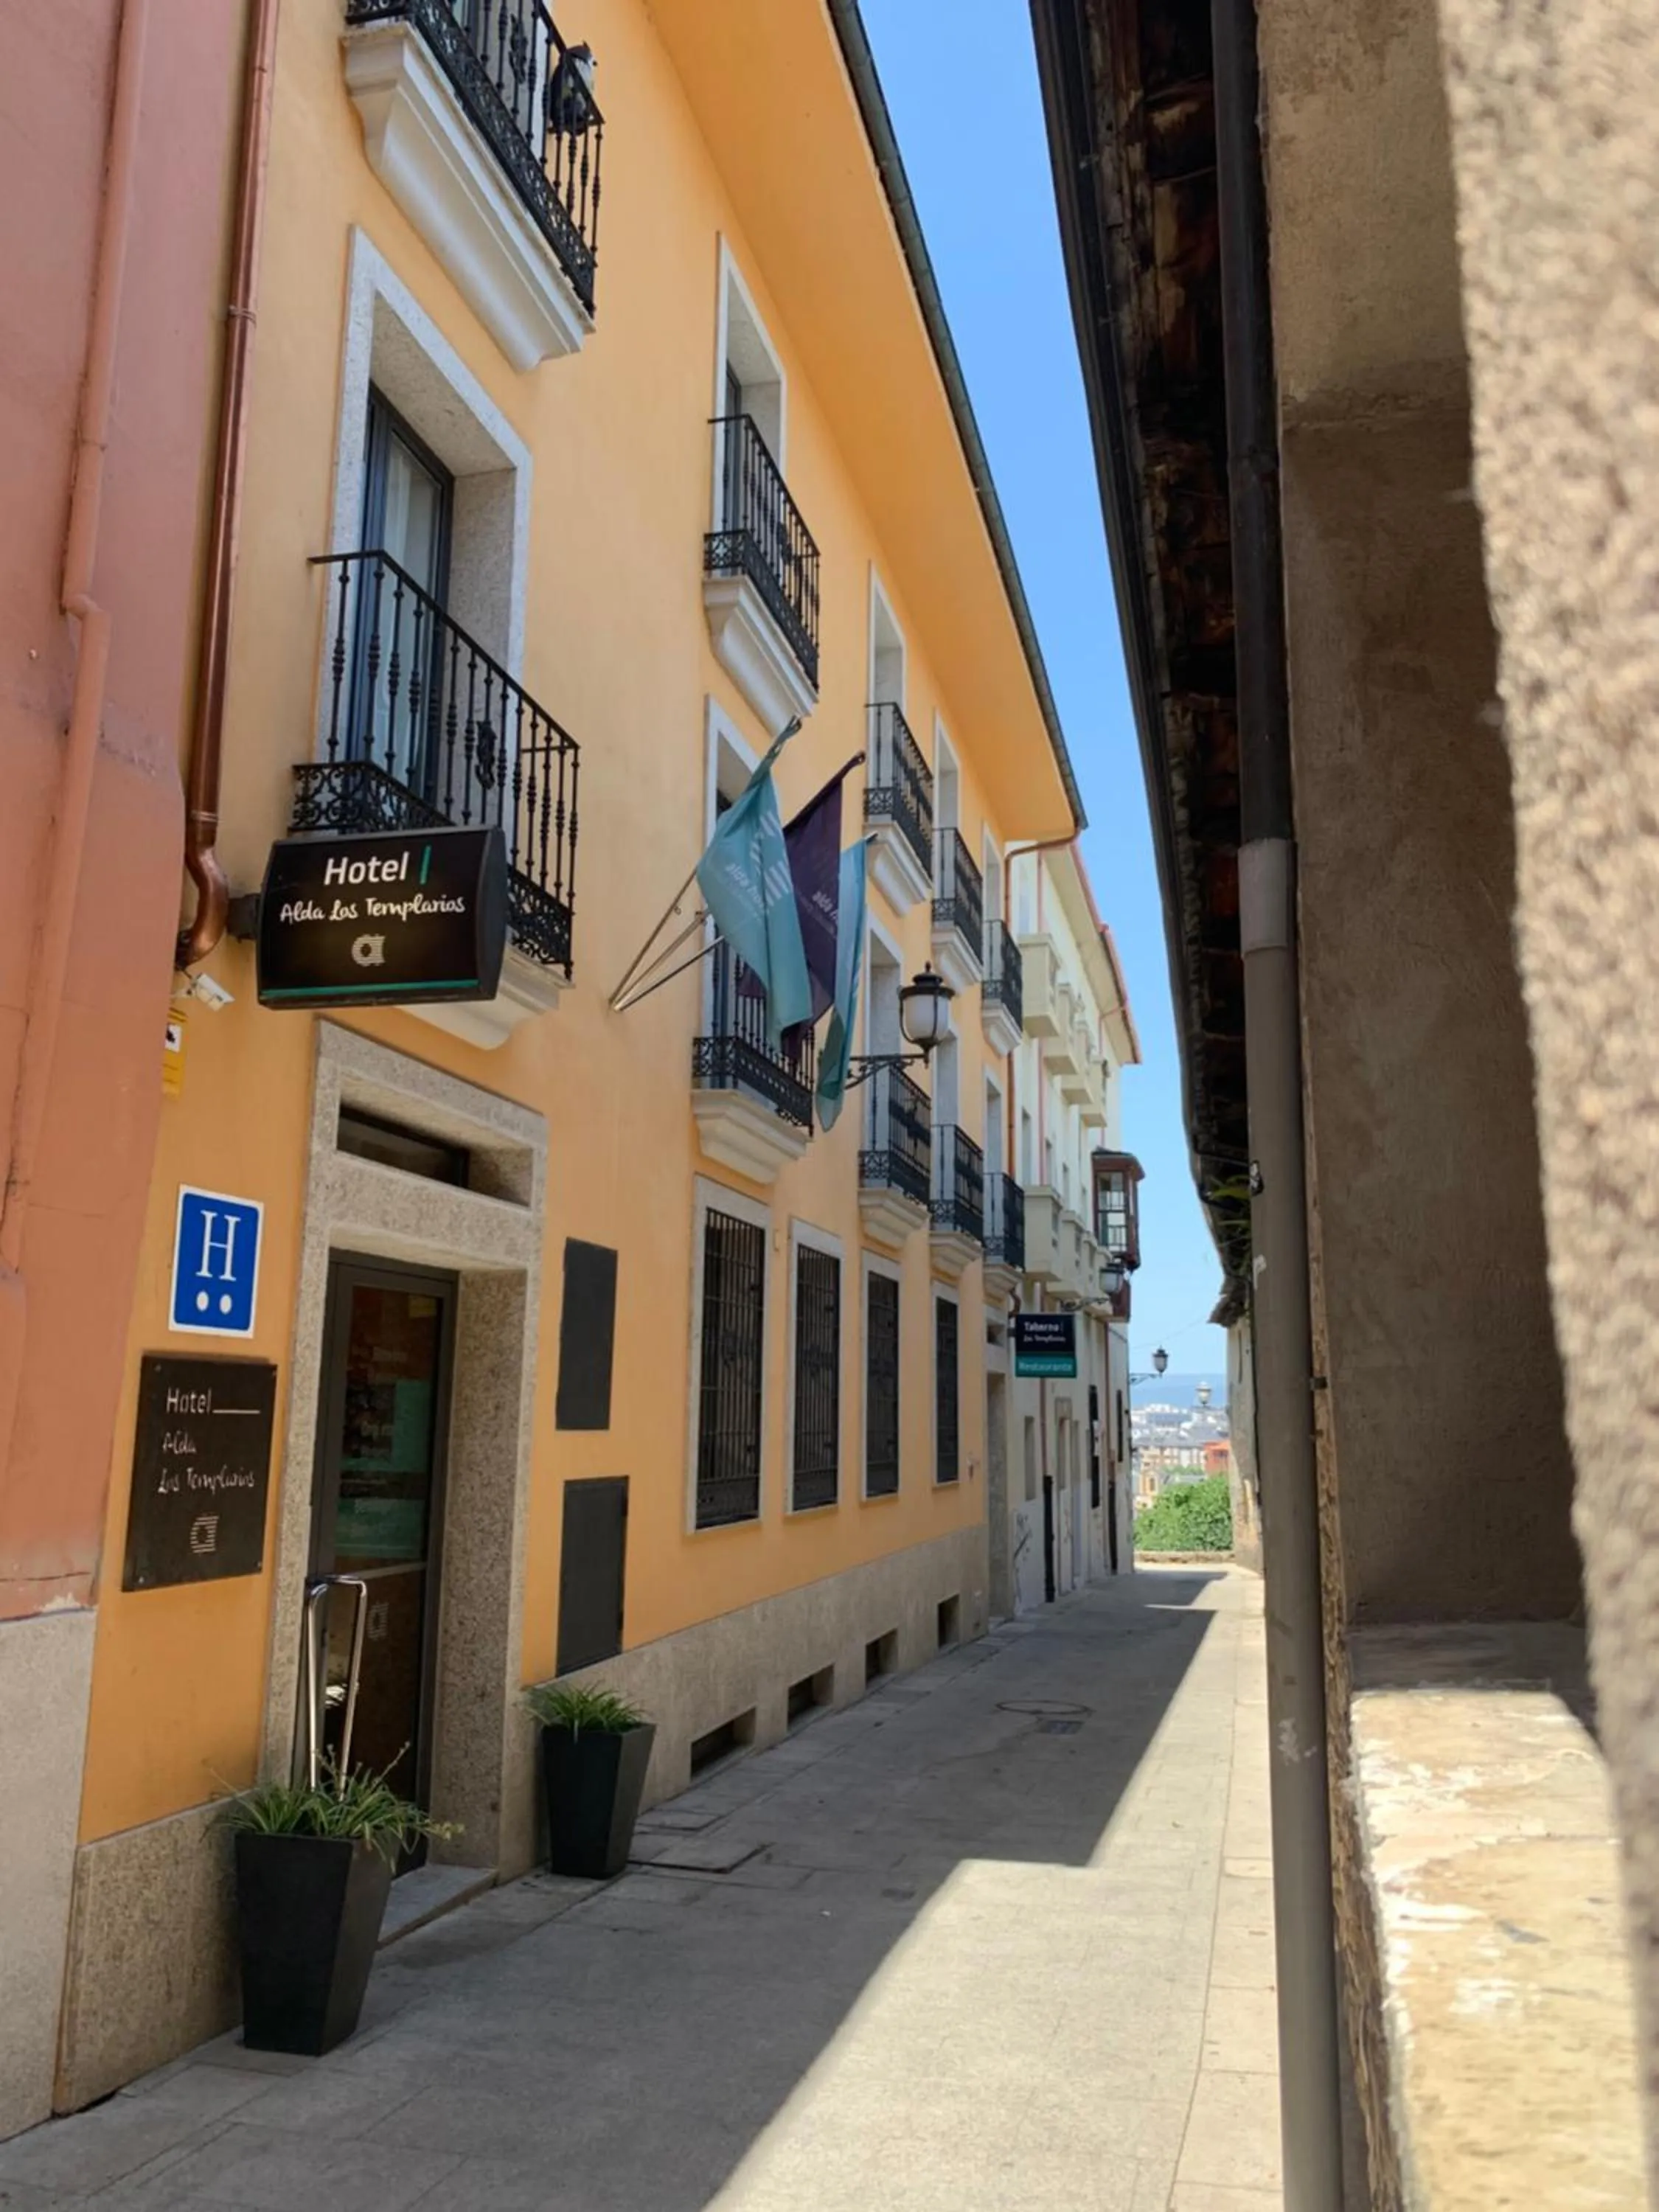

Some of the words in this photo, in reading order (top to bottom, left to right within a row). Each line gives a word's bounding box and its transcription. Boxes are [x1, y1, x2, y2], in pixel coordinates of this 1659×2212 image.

[324, 851, 409, 886] Hotel
[280, 900, 326, 923] Alda
[330, 899, 358, 921] Los
[366, 893, 466, 922] Templarios
[195, 1210, 240, 1281] H
[166, 1385, 212, 1414] Hotel
[161, 1430, 197, 1455] Alda
[186, 1464, 255, 1495] Templarios
